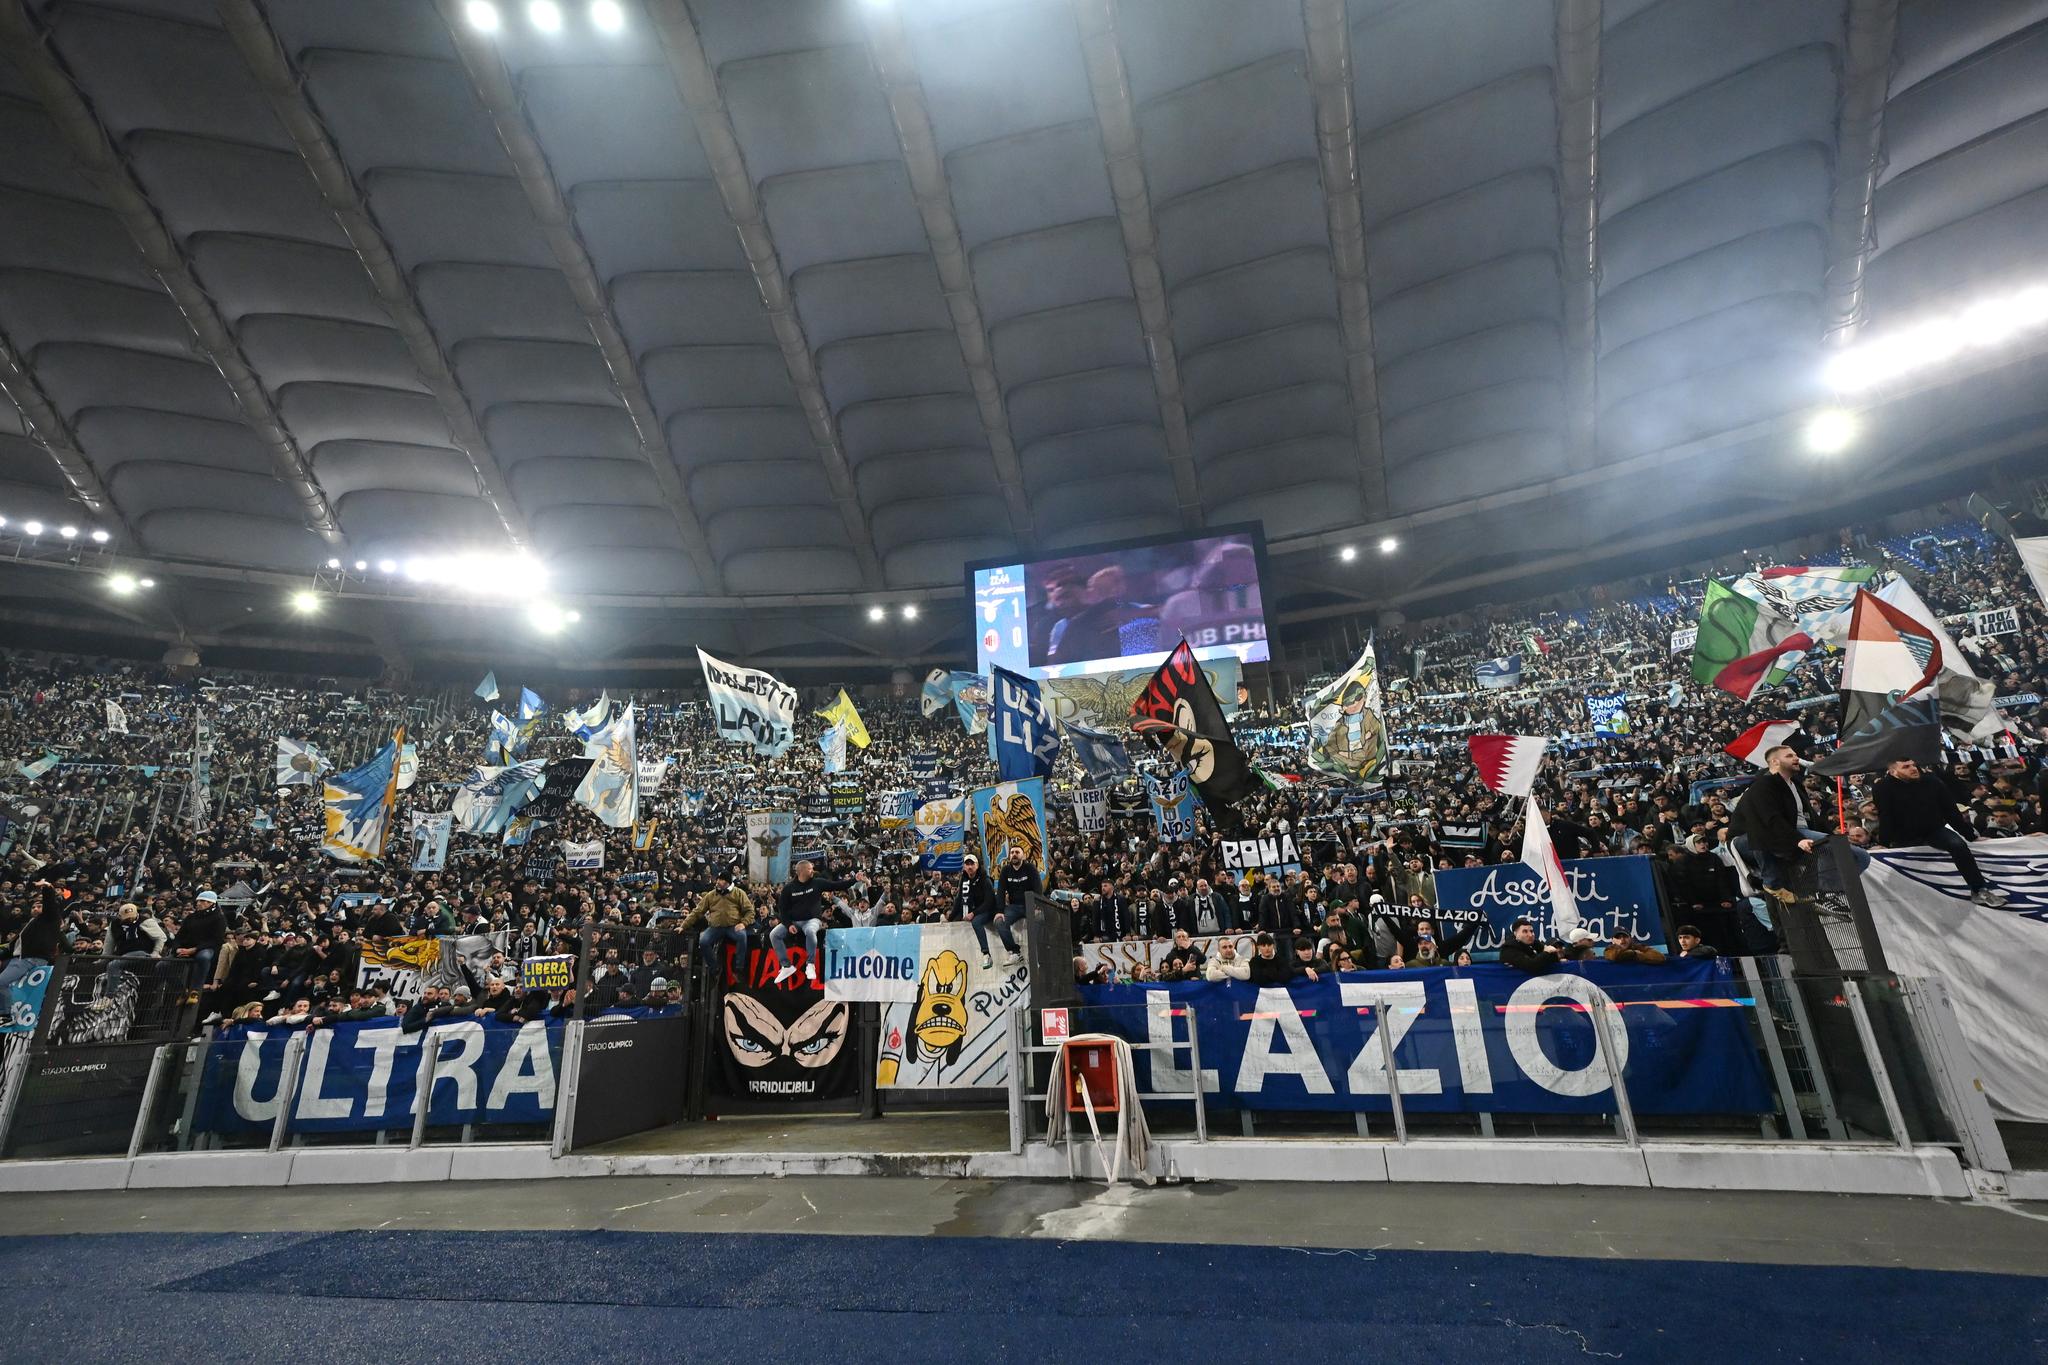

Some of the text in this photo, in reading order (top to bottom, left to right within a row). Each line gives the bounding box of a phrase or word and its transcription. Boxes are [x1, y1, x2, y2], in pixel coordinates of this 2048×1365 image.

[1012, 597, 1019, 617] 1
[1979, 609, 2012, 624] 100%
[1980, 620, 2016, 635] LAZIO
[1587, 694, 1626, 709] SUNDAY
[834, 797, 863, 805] BRIVIDI
[881, 794, 912, 804] C'MON
[1072, 790, 1105, 803] LIBERA
[1390, 798, 1414, 808] LAZIO
[881, 804, 914, 816] LAZIO
[1083, 806, 1097, 818] LA
[1221, 834, 1300, 868] ROMA
[527, 858, 555, 868] LOTITO
[525, 868, 555, 879] VATTENE
[1470, 867, 1609, 907] Asseti
[1377, 904, 1479, 922] ULTRAS LAZIO
[525, 961, 568, 976] LIBERA
[830, 949, 914, 980] Lucone
[525, 974, 568, 988] LA LAZIO
[1146, 973, 1630, 1098] LAZIO
[587, 1040, 633, 1051] STADIO OLIMPICO
[749, 1080, 815, 1094] IRRIDUCIBILI
